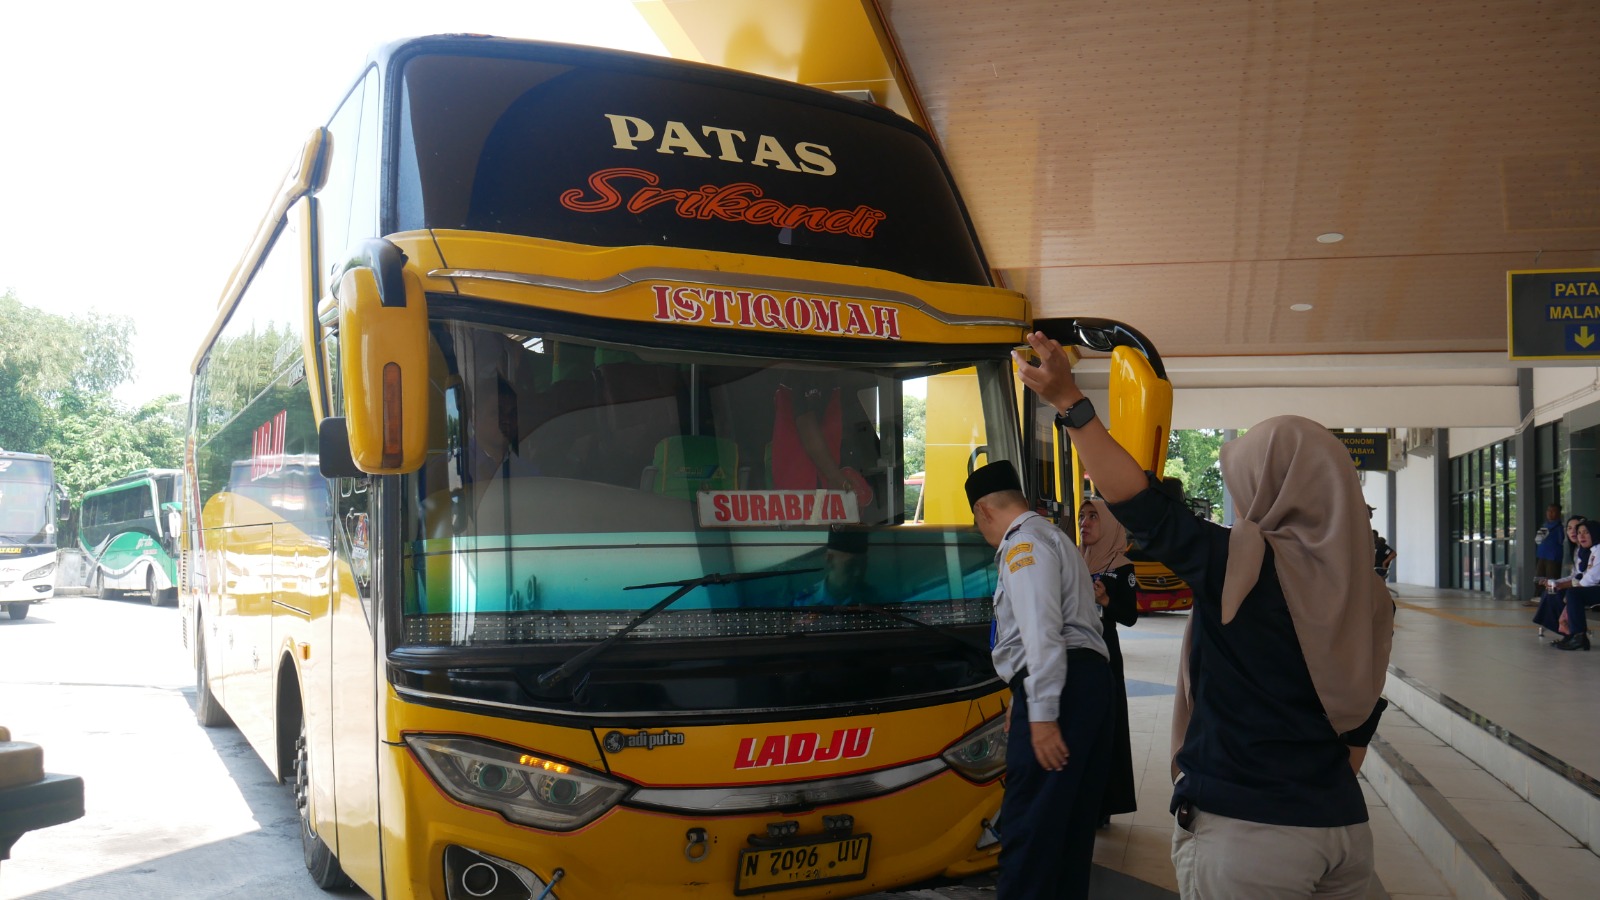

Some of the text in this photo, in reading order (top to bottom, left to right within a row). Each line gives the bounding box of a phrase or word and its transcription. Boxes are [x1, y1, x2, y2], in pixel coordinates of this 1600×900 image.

[604, 113, 837, 176] PATAS
[560, 167, 887, 239] Srikandi
[652, 285, 900, 339] ISTIQOMAH
[734, 727, 875, 770] LADJU
[745, 839, 863, 876] N 7096 UV
